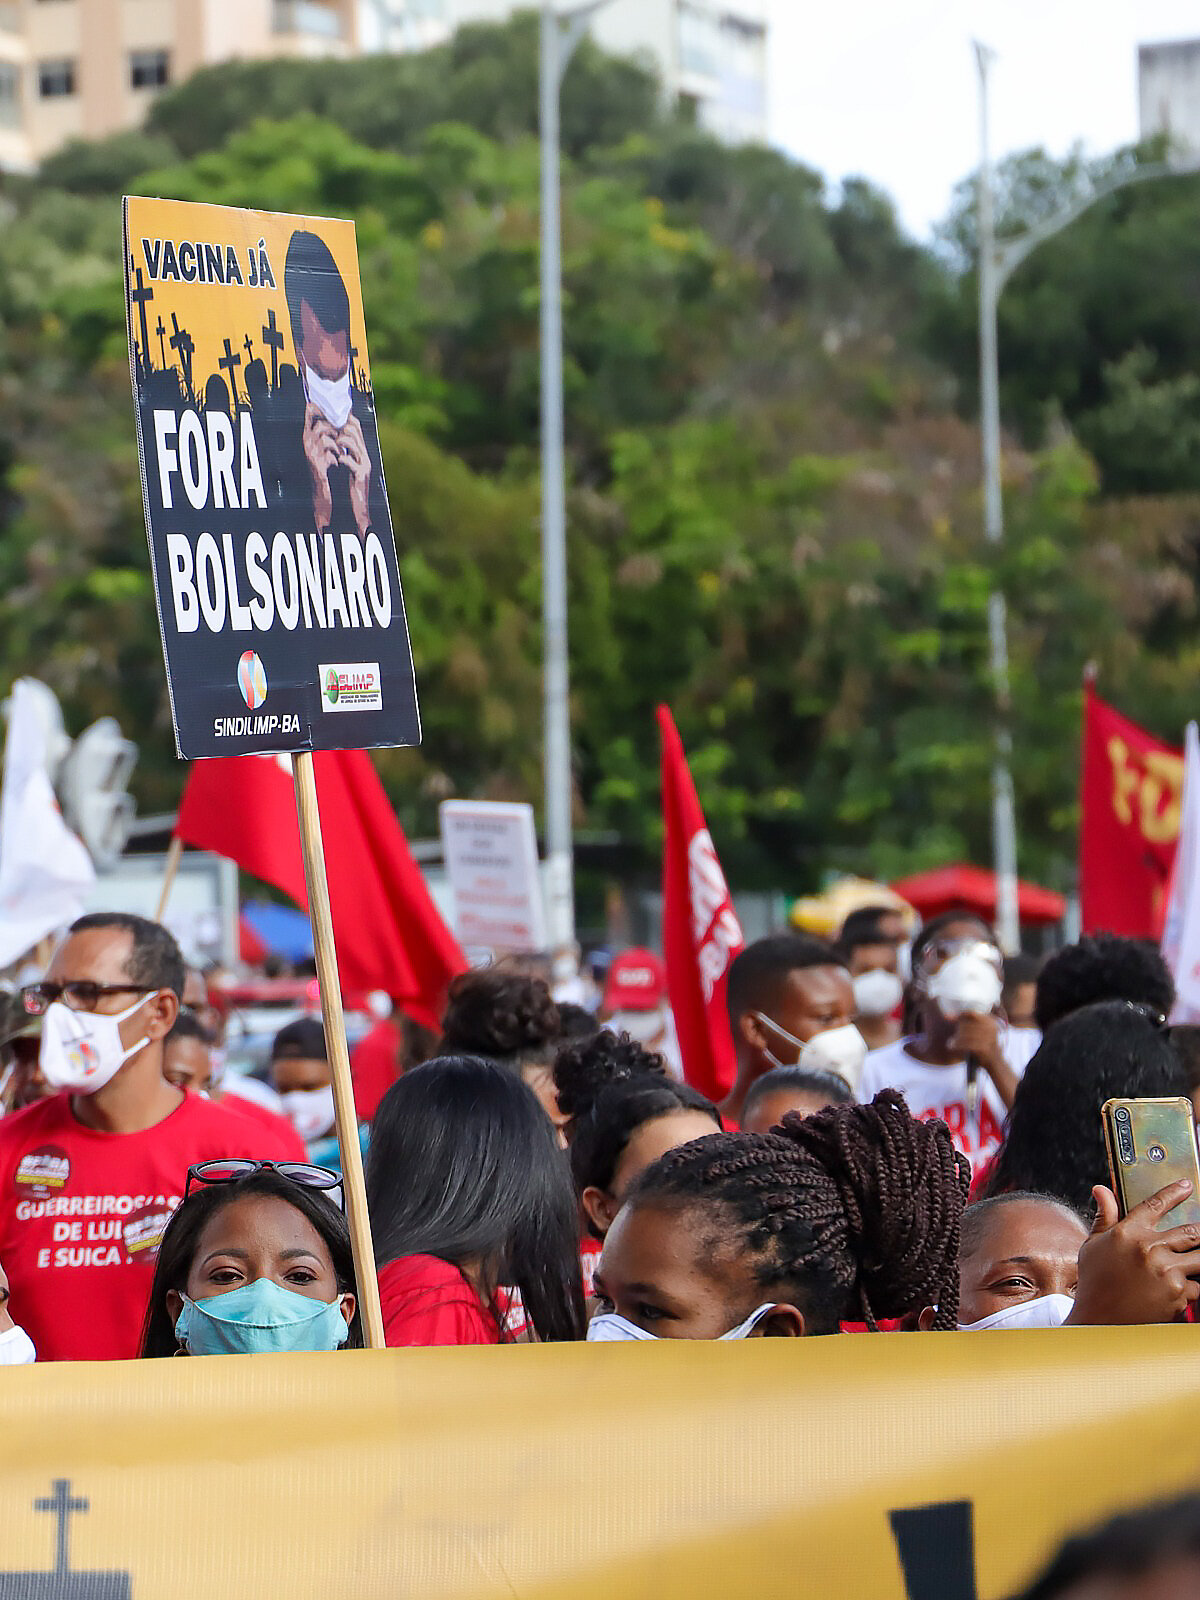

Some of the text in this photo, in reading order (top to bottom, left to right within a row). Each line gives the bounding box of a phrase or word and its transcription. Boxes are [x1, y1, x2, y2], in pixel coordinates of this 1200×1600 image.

[142, 238, 277, 290] VACINA JÁ
[153, 408, 268, 510] FORA
[167, 531, 392, 634] BOLSONARO
[37, 1246, 122, 1268] E SUICA
[53, 1221, 83, 1242] DE
